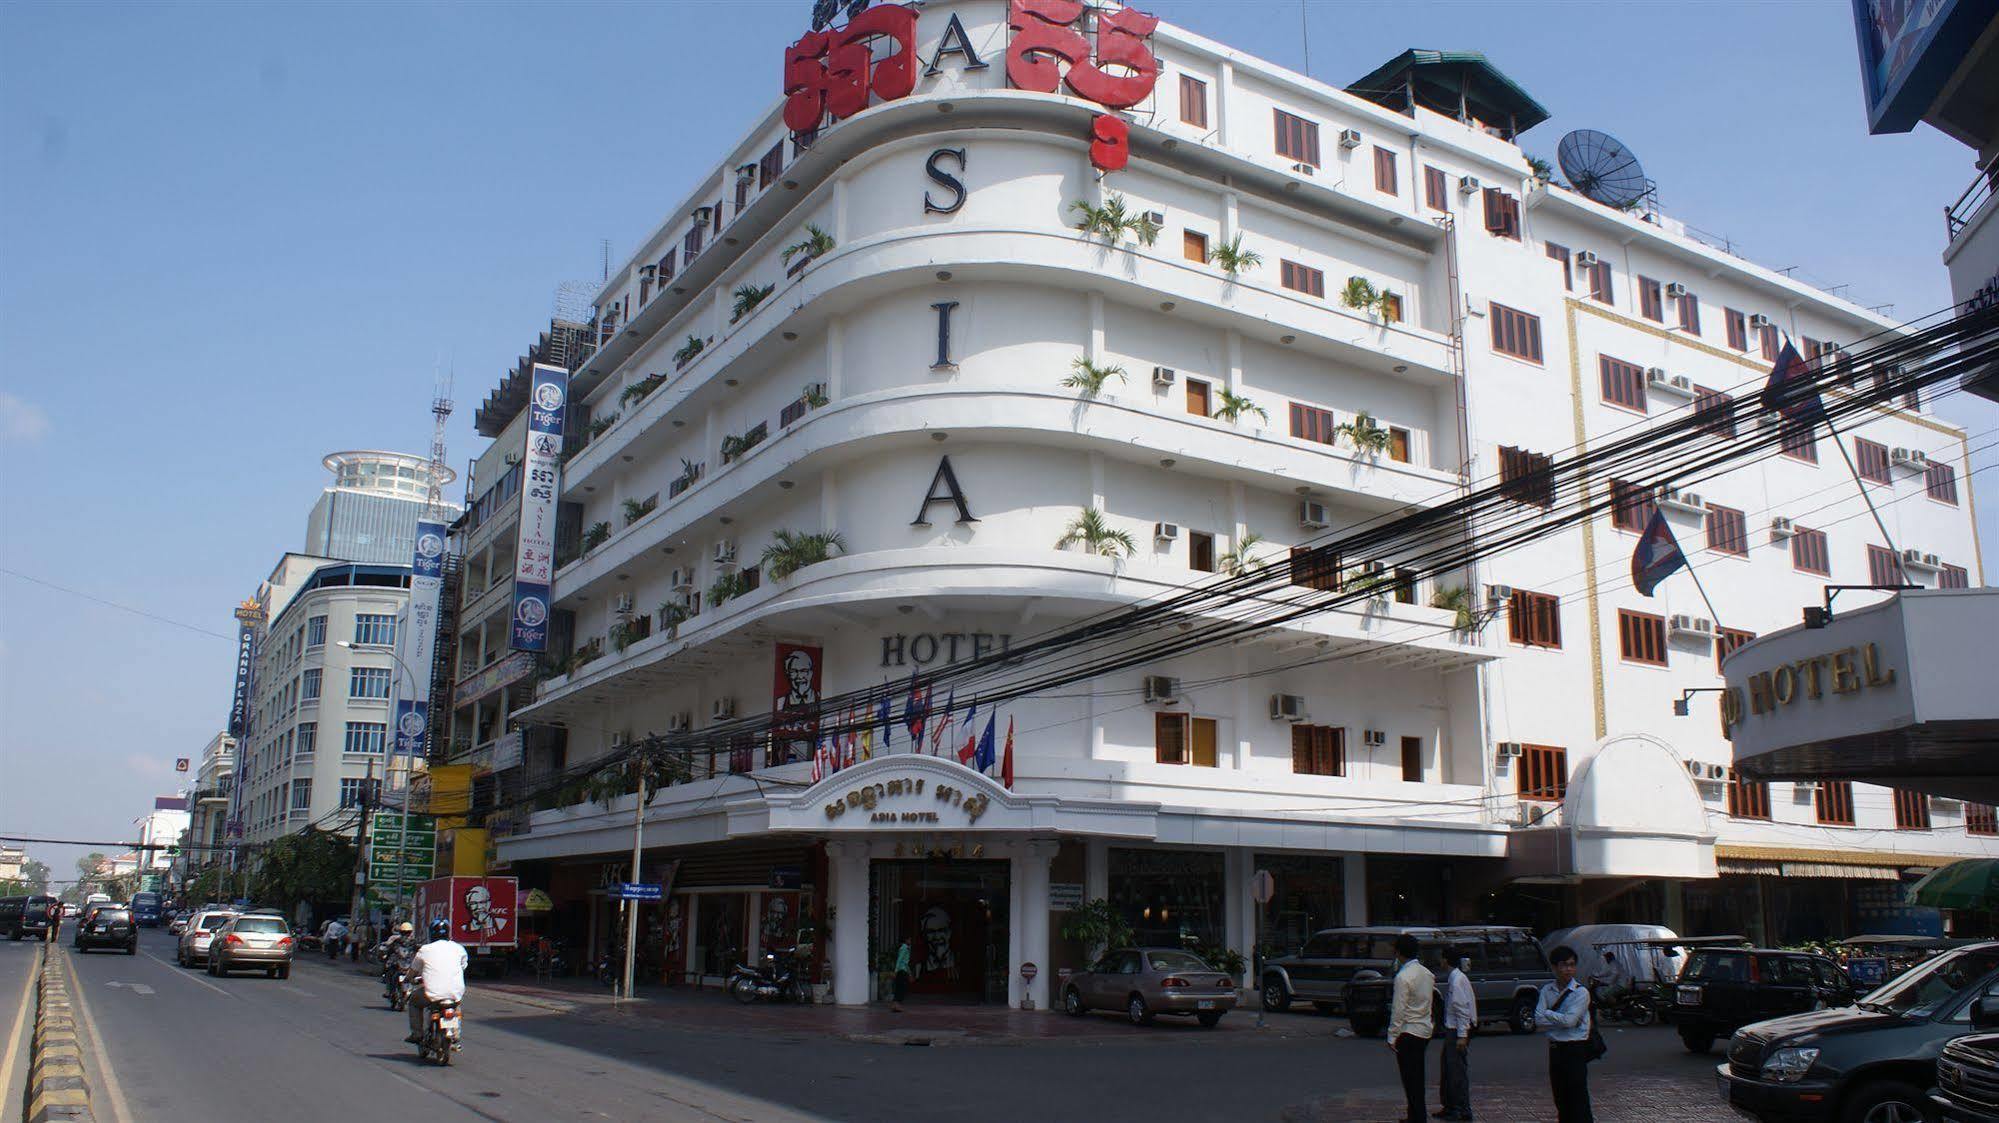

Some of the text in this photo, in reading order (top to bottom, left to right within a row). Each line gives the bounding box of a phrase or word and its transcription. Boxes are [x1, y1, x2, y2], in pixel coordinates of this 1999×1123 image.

[910, 11, 989, 527] ASIA
[533, 411, 562, 427] Tiger
[416, 558, 440, 571] Tiger
[236, 609, 262, 619] HOTEL
[515, 627, 545, 642] Tiger
[239, 633, 252, 675] GRAND
[880, 632, 1024, 667] HOTEL
[1747, 641, 1896, 715] HOTEL
[233, 681, 246, 723] PLAZA
[870, 812, 940, 823] ASIA HOTEL
